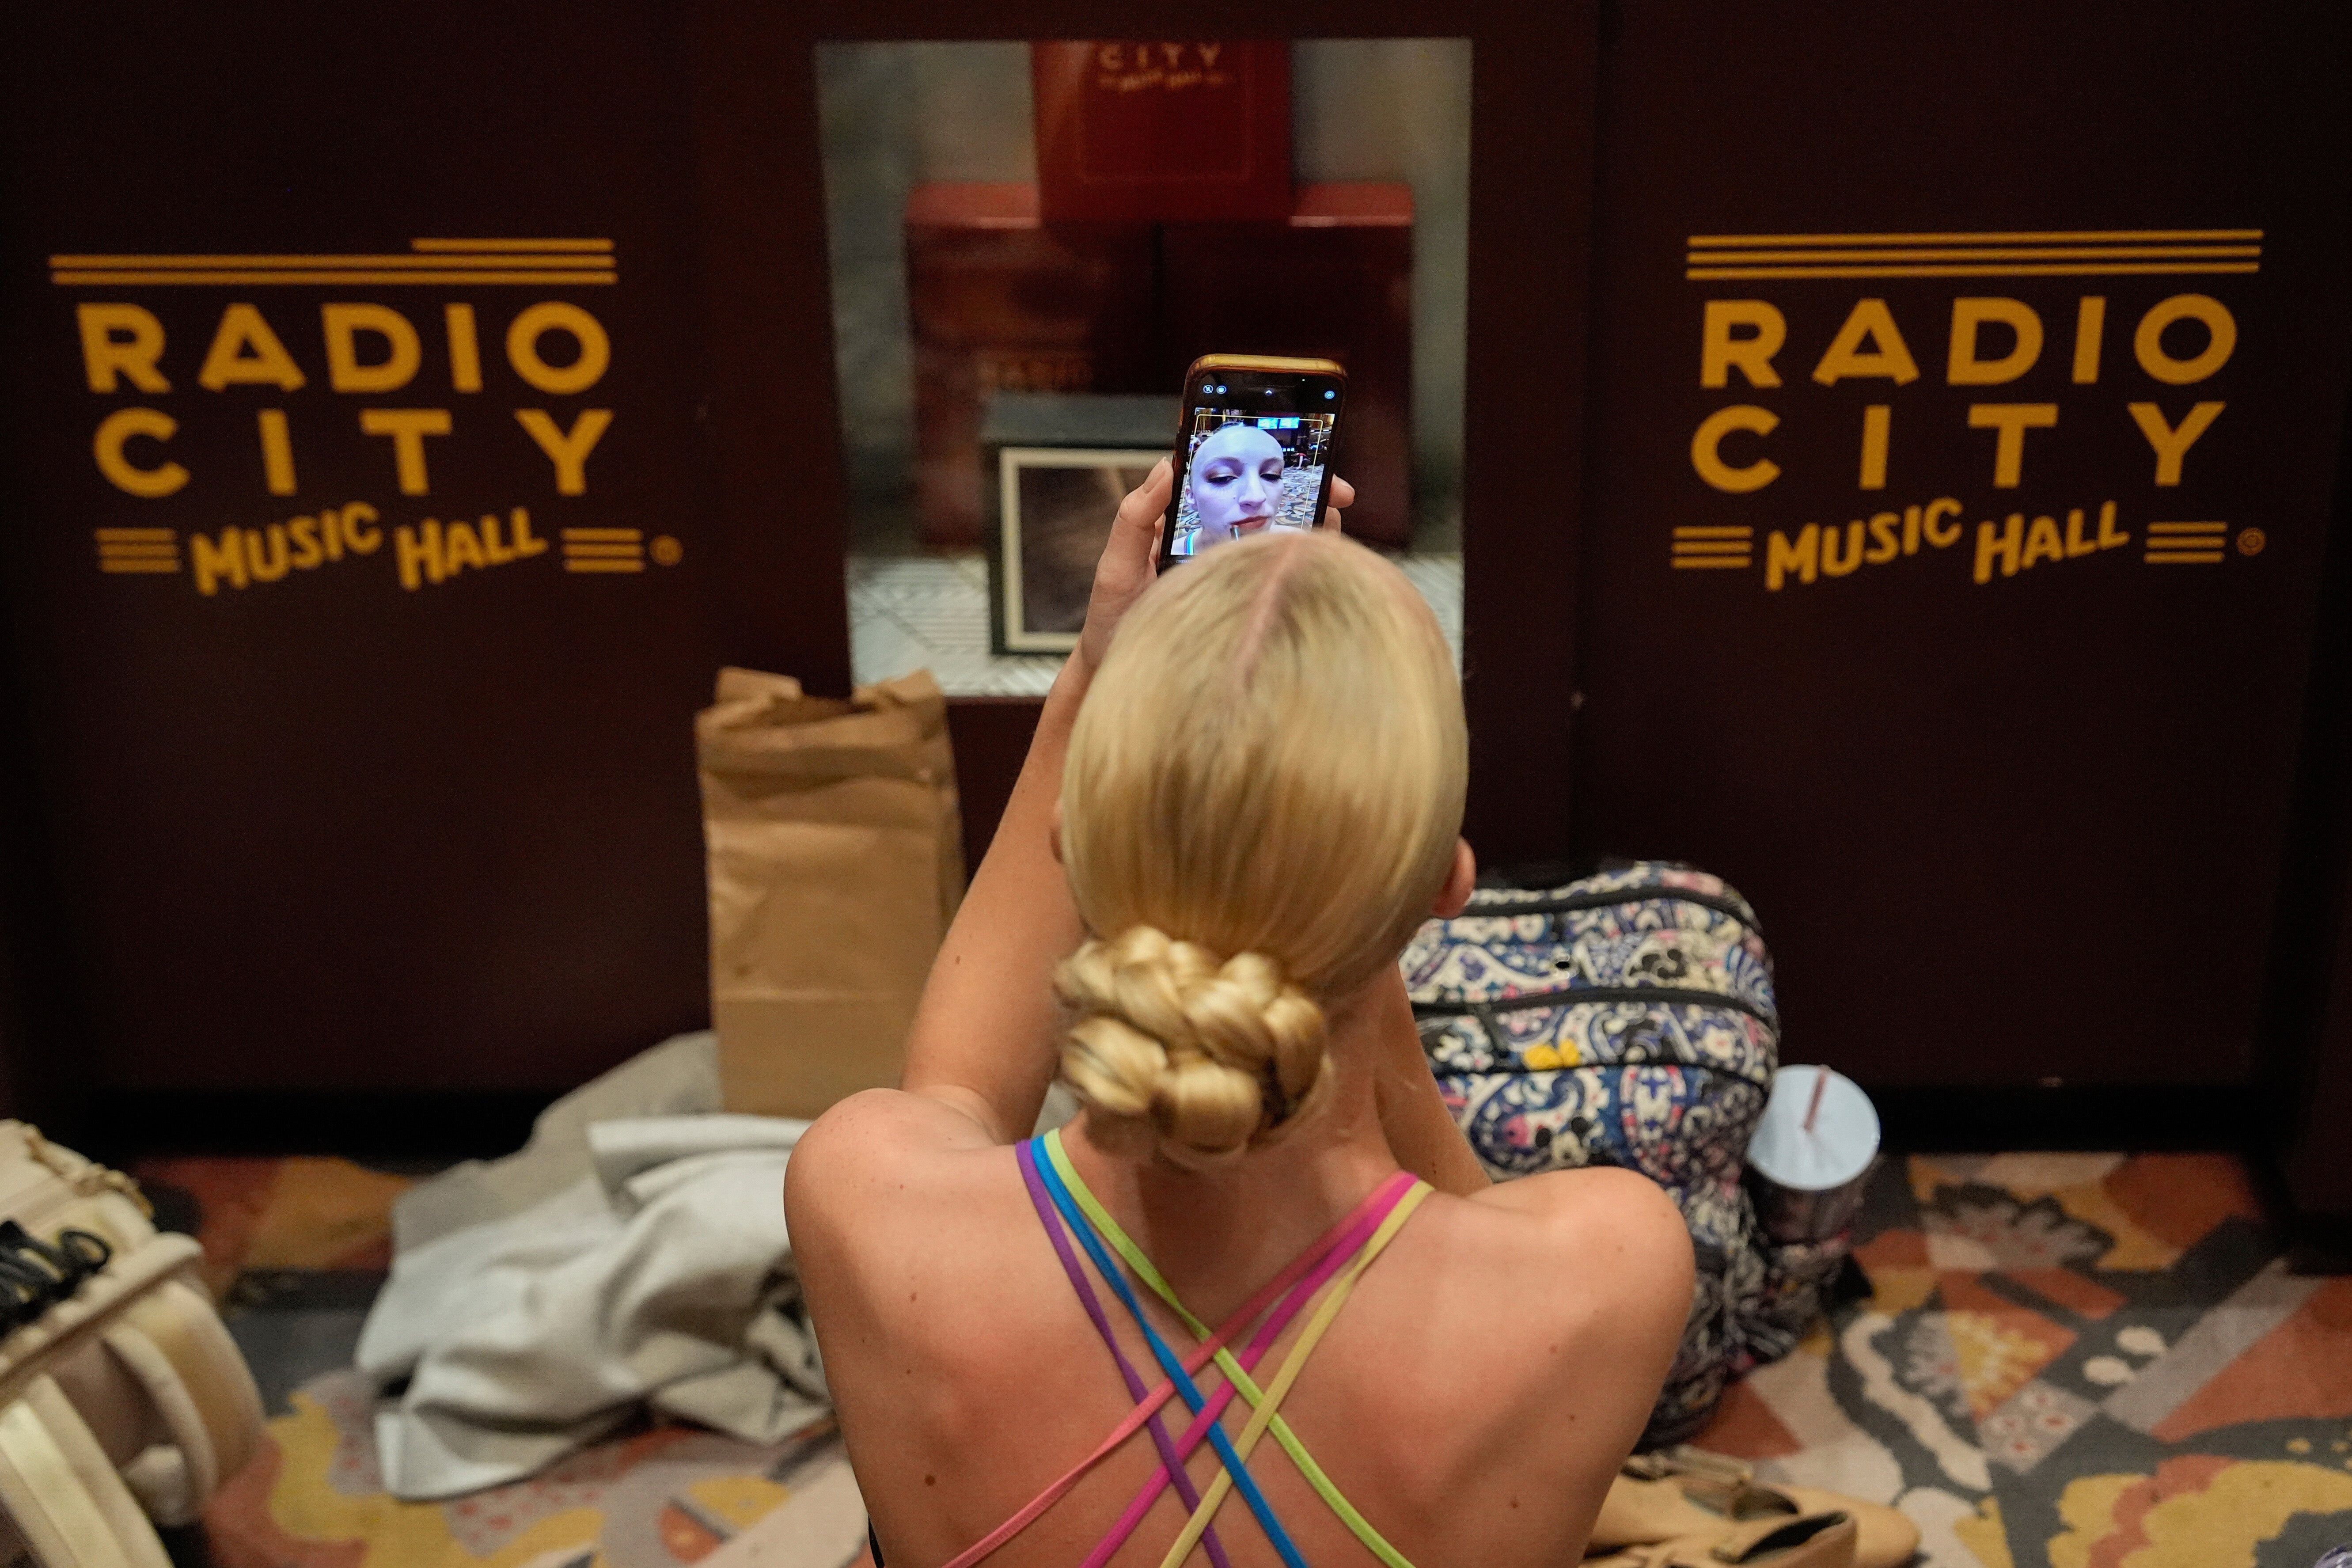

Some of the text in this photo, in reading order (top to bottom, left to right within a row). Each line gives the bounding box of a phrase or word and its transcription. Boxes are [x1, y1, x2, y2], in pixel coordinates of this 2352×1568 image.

[1099, 42, 1223, 71] CITY
[76, 300, 611, 395] RADIO
[1699, 293, 2238, 389] RADIO
[93, 407, 615, 498] CITY
[1690, 401, 2226, 494] CITY
[190, 501, 548, 596] MUSIC HALL
[1765, 497, 2131, 592] MUSIC HALL
